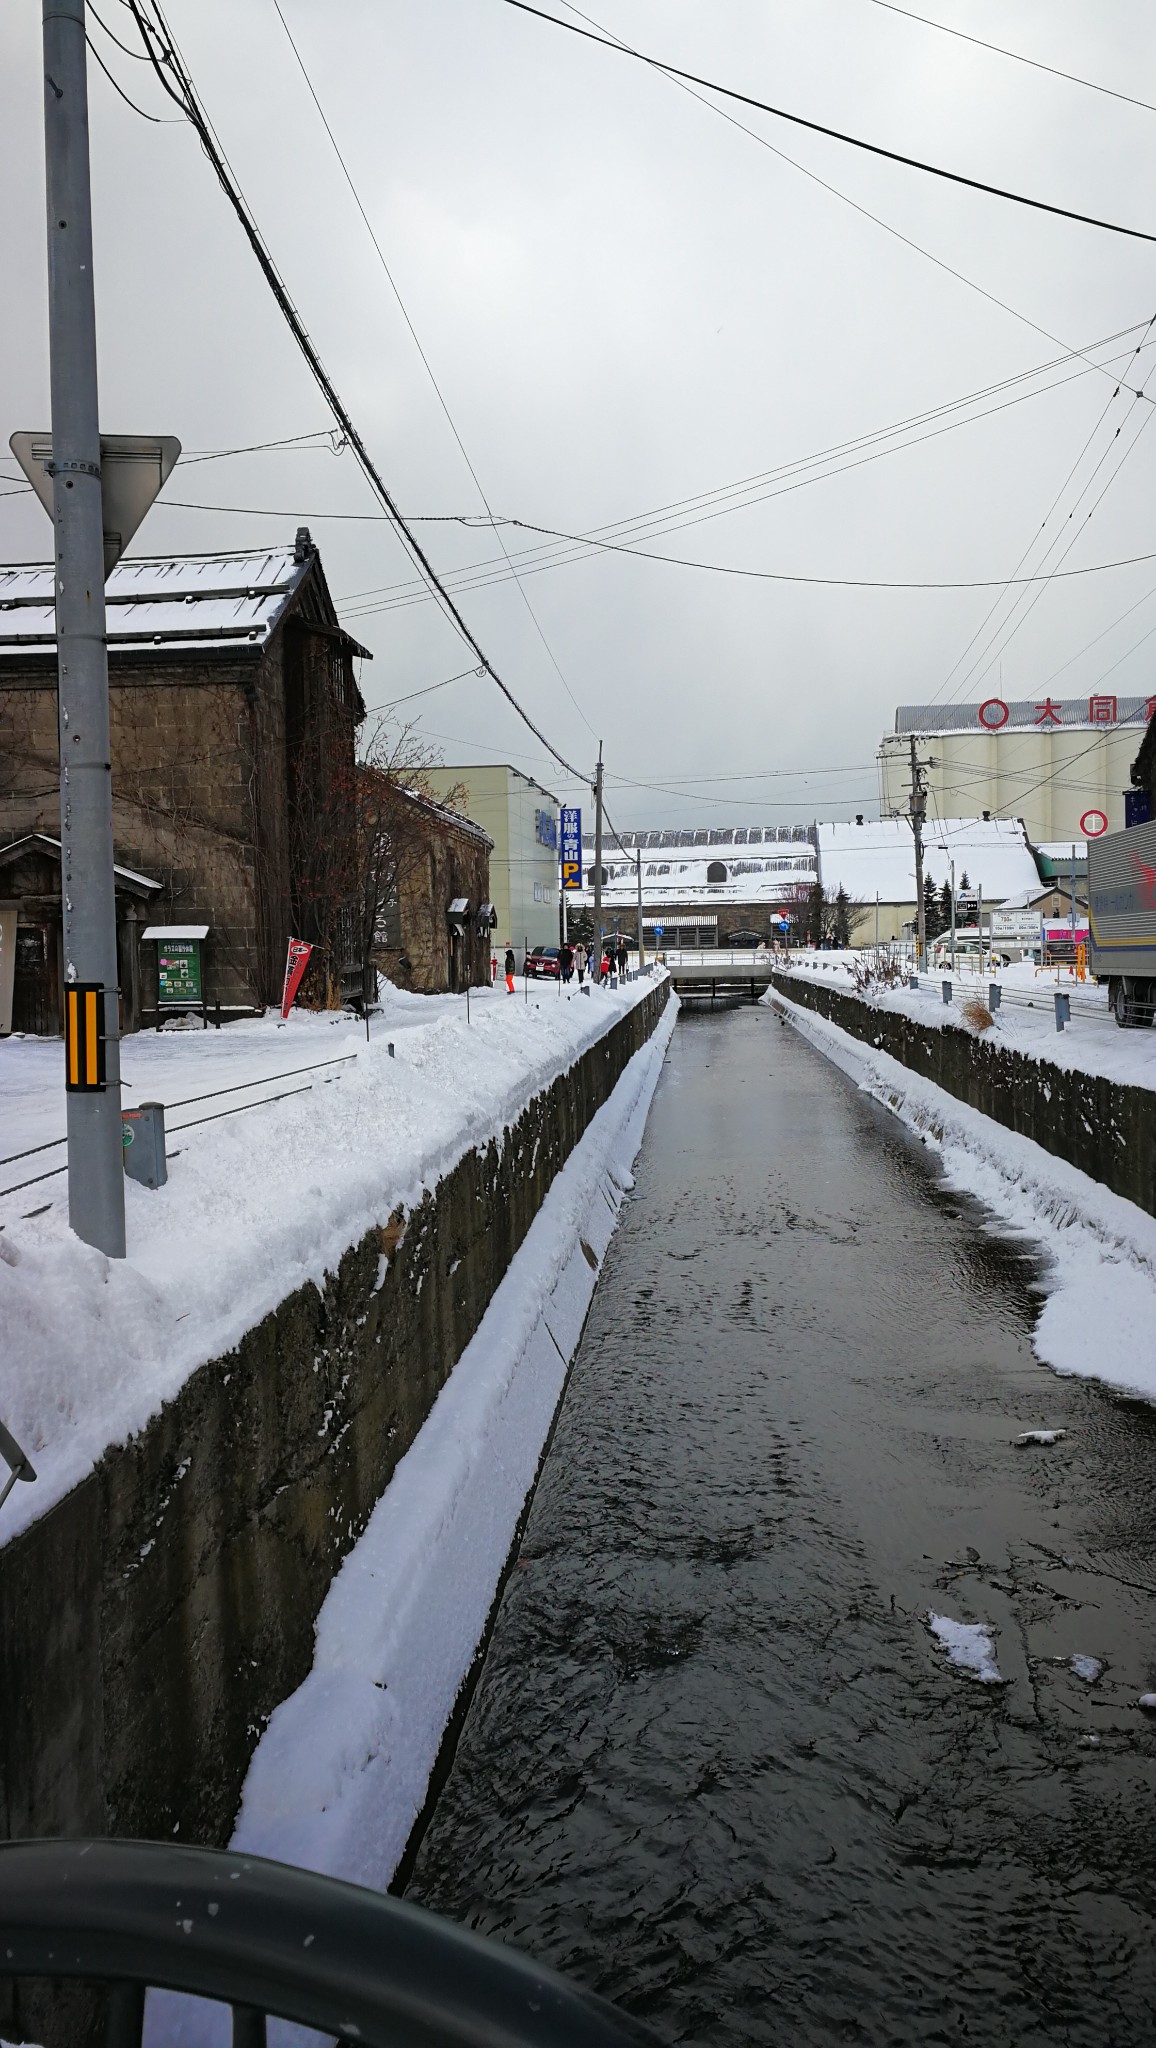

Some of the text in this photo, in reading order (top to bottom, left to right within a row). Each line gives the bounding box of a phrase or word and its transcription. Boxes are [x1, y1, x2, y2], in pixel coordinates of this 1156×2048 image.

[563, 810, 579, 861] 洋服の青山
[563, 863, 579, 879] P
